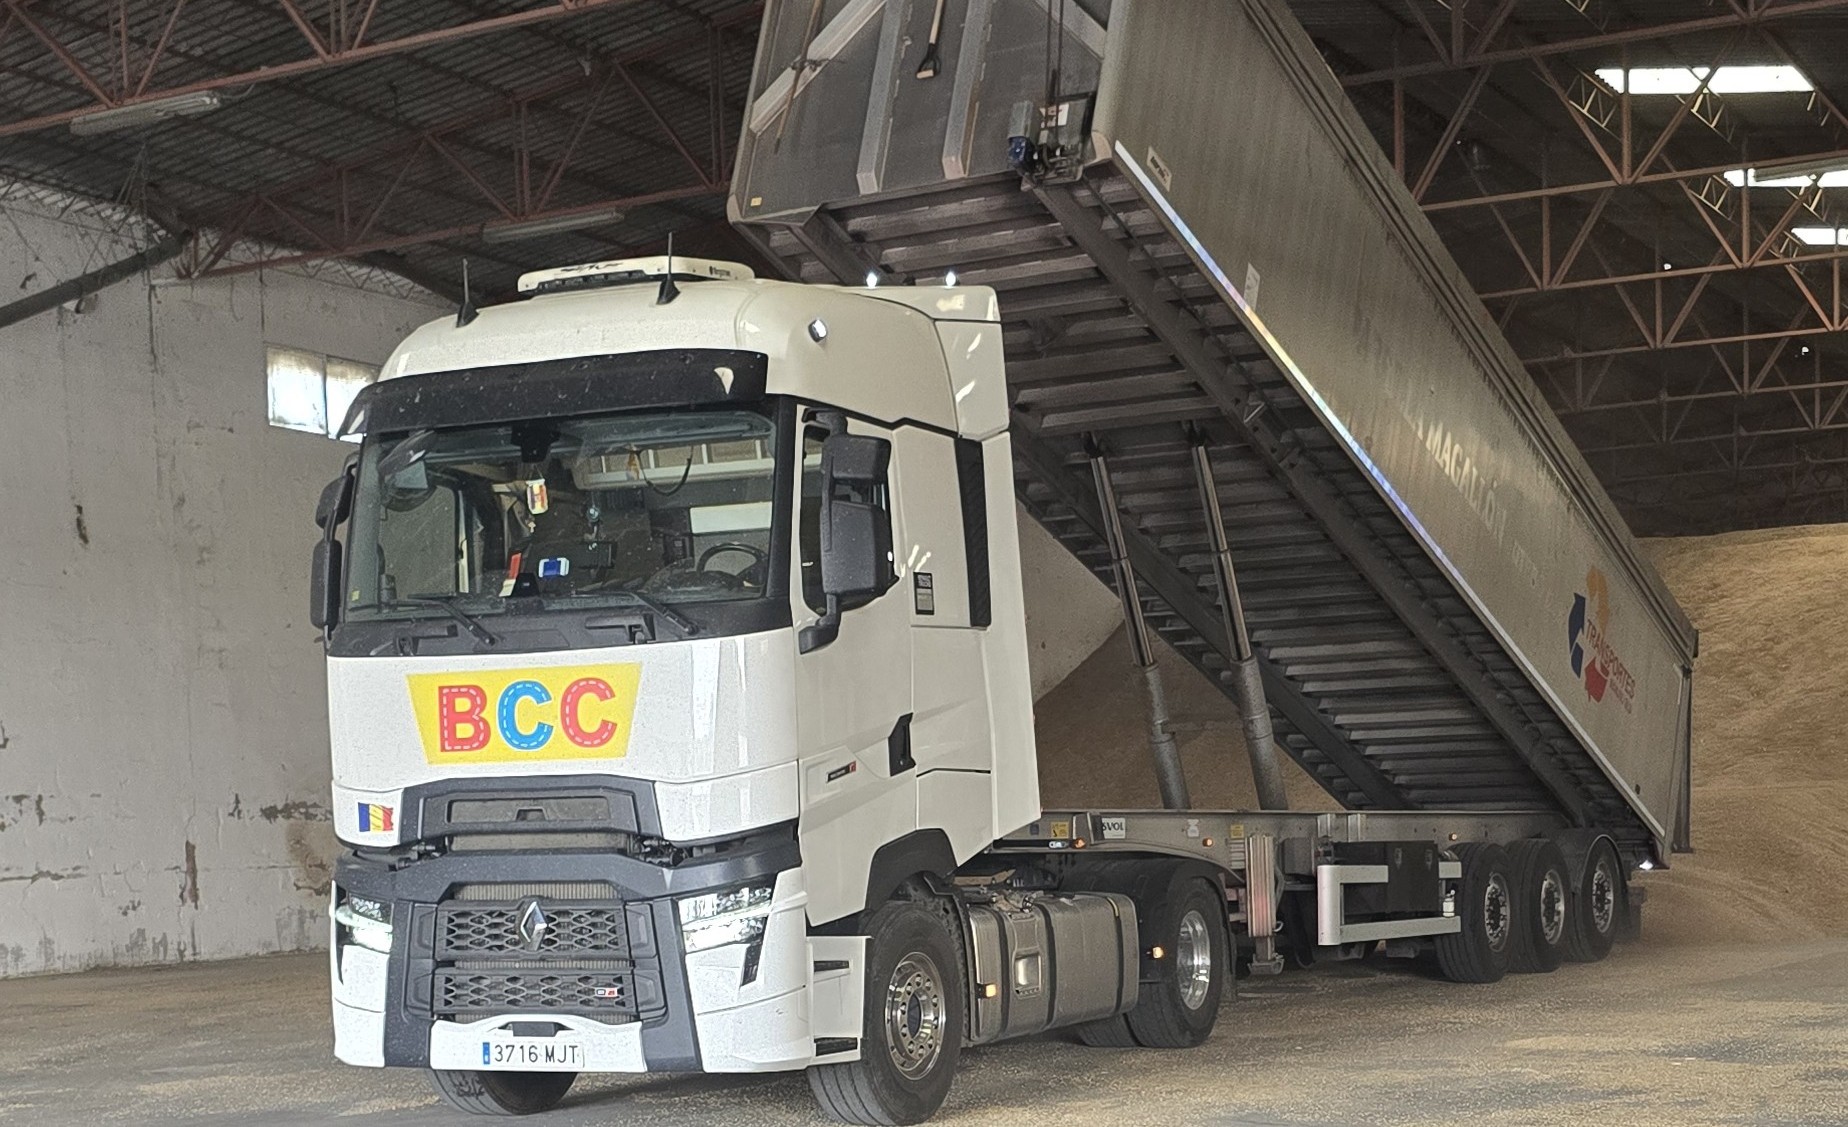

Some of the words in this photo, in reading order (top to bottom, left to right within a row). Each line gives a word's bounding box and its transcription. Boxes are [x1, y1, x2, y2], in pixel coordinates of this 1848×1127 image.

[438, 677, 618, 753] BCC
[494, 1044, 539, 1063] 3716
[545, 1044, 579, 1064] MJT
